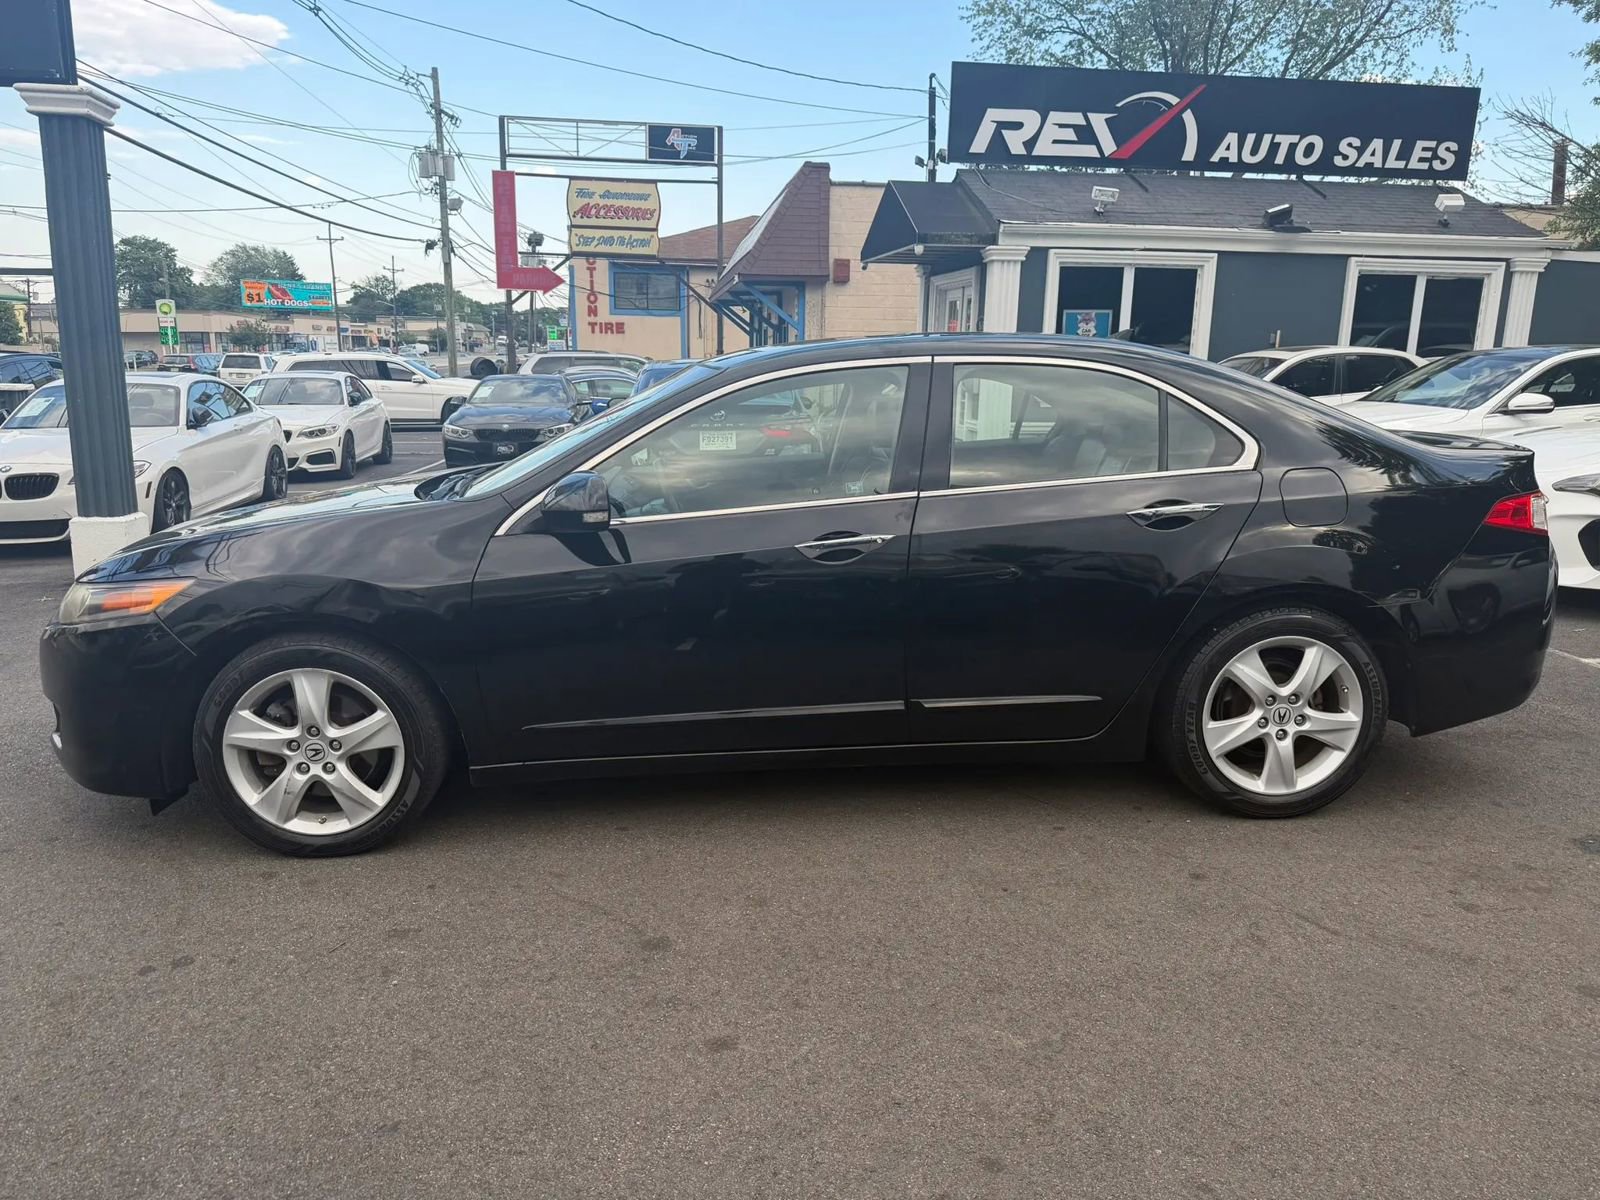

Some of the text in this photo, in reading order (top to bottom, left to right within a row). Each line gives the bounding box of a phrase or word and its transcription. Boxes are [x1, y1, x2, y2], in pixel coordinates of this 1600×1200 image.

[1209, 132, 1324, 166] AUTO
[1333, 136, 1459, 171] SALES
[572, 202, 657, 221] ACCESSORIES
[246, 291, 264, 304] $1
[284, 299, 309, 307] DOGS
[588, 322, 626, 335] TIRE
